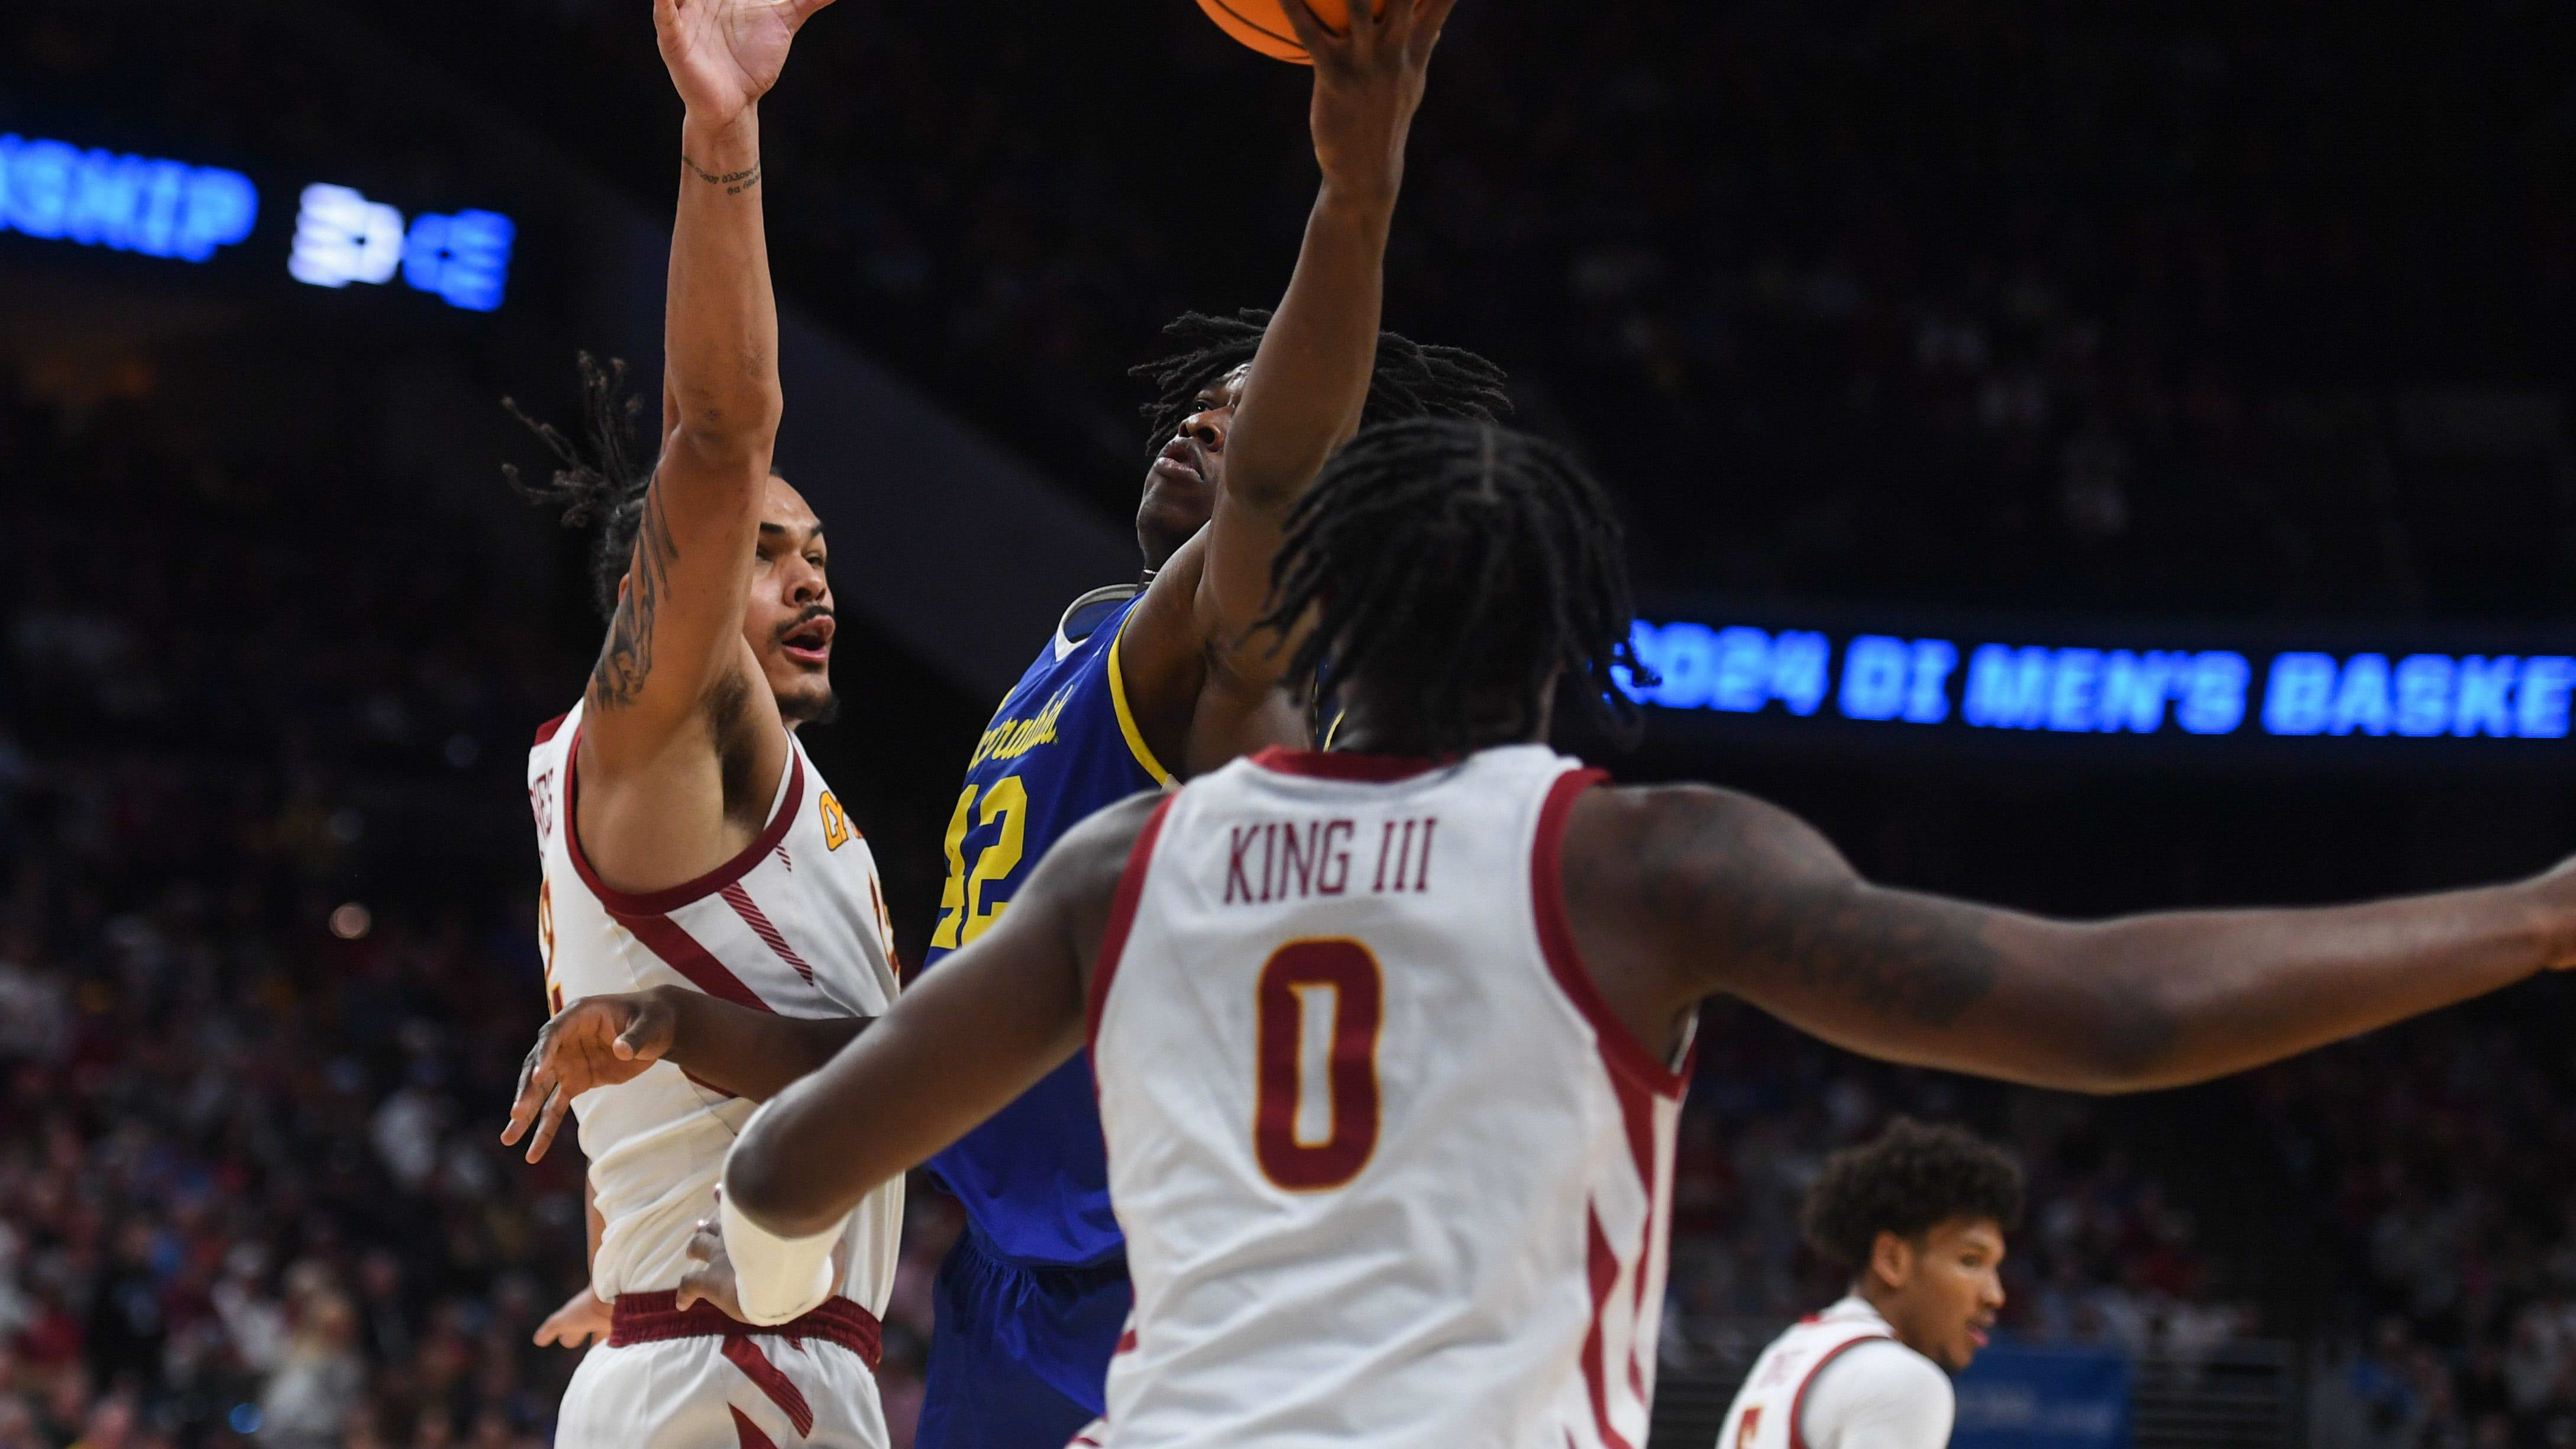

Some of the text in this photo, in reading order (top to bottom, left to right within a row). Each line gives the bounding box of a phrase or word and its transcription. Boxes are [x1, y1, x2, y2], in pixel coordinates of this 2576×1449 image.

[1961, 643, 2251, 734] MEN'S
[1223, 817, 1437, 904] KING III
[1252, 934, 1385, 1194] 0
